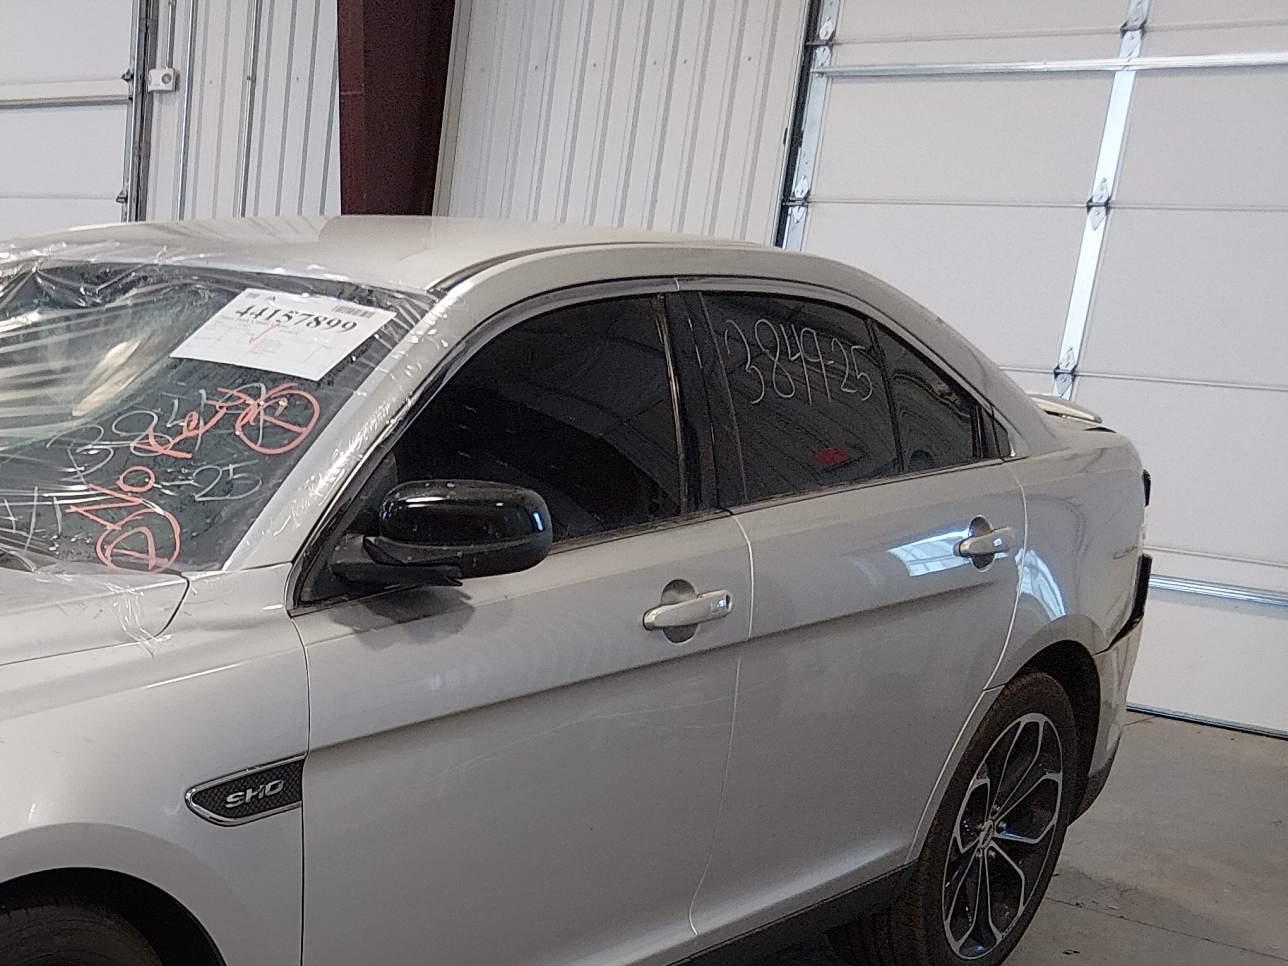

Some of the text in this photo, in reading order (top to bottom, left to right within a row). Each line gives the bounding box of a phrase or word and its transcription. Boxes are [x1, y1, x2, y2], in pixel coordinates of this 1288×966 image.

[235, 304, 358, 333] 44157899
[723, 318, 873, 404] 3849-25
[225, 779, 284, 808] SHO
